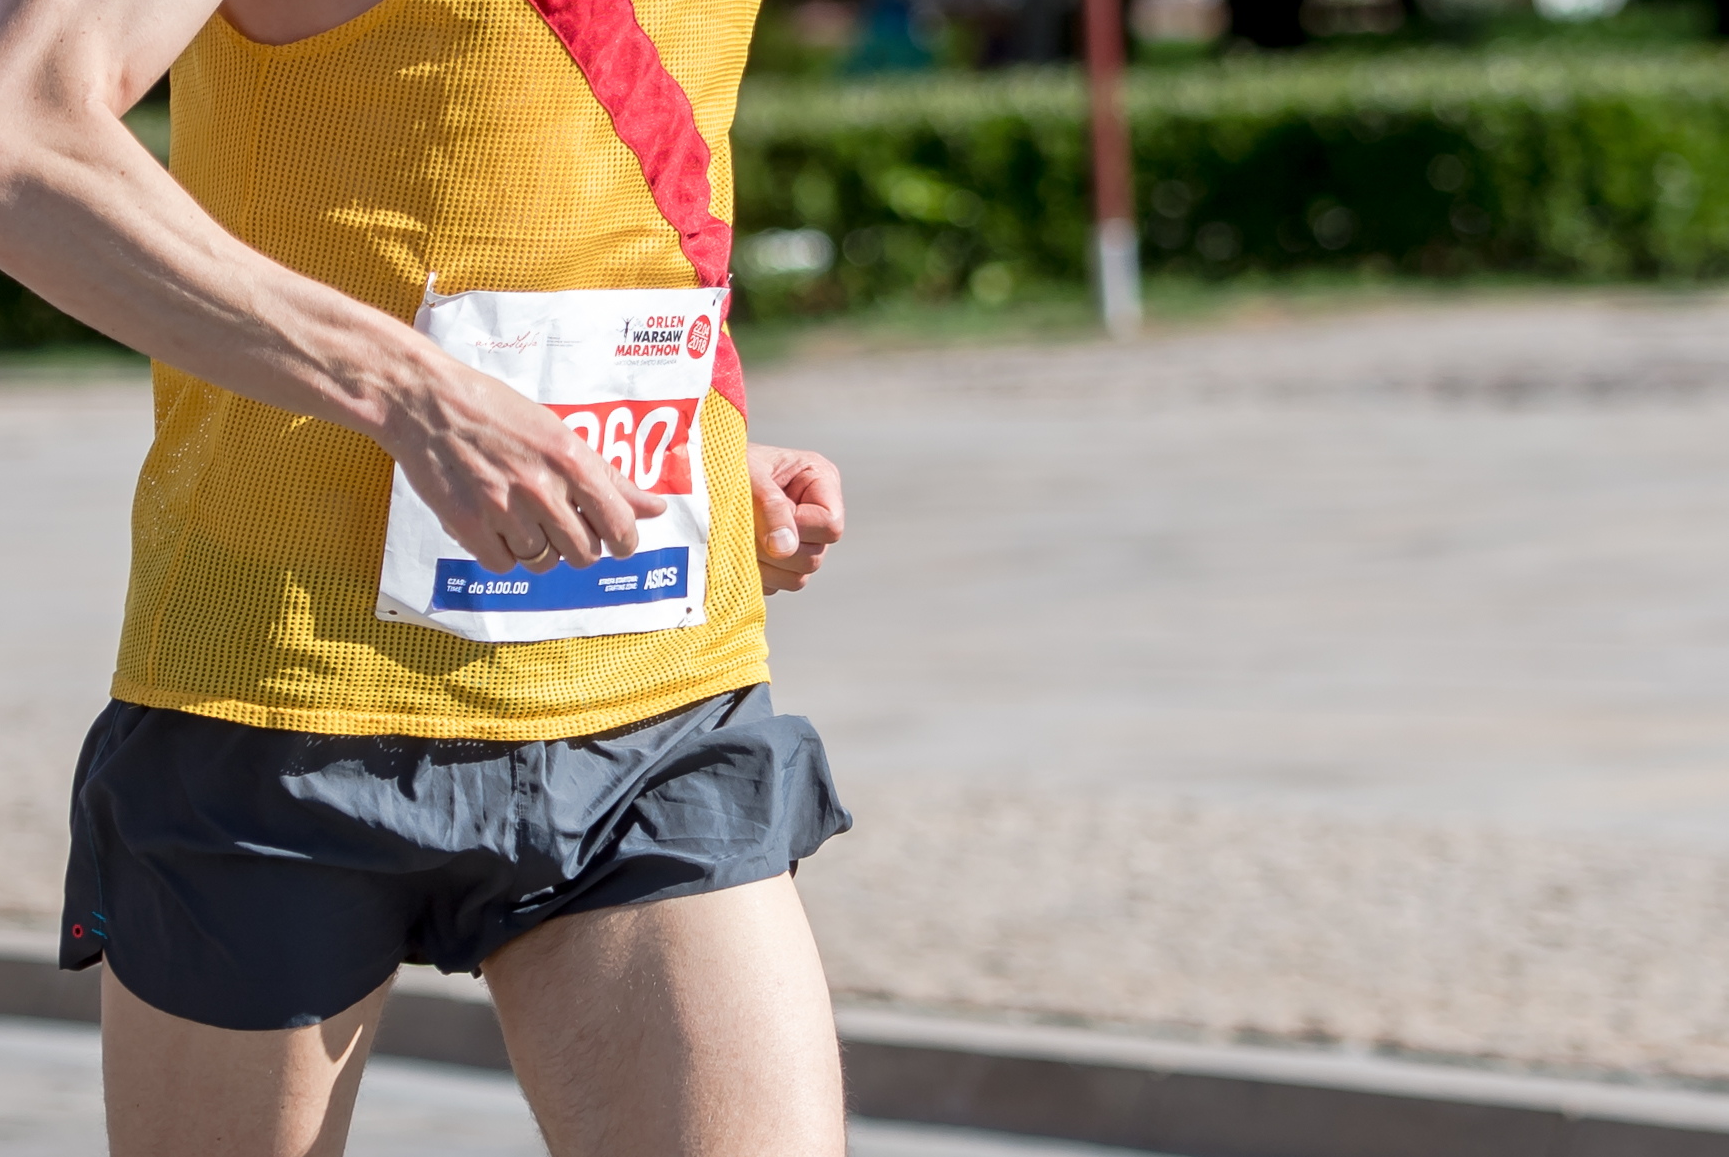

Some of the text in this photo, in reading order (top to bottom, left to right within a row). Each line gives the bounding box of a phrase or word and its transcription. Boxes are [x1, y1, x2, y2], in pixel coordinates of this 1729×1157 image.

[646, 315, 686, 329] ORLEN
[632, 330, 684, 344] WARSAW
[614, 344, 681, 358] MARATHON
[687, 335, 708, 354] 2018
[643, 566, 678, 591] ASICS
[467, 580, 529, 595] do 3.00.00
